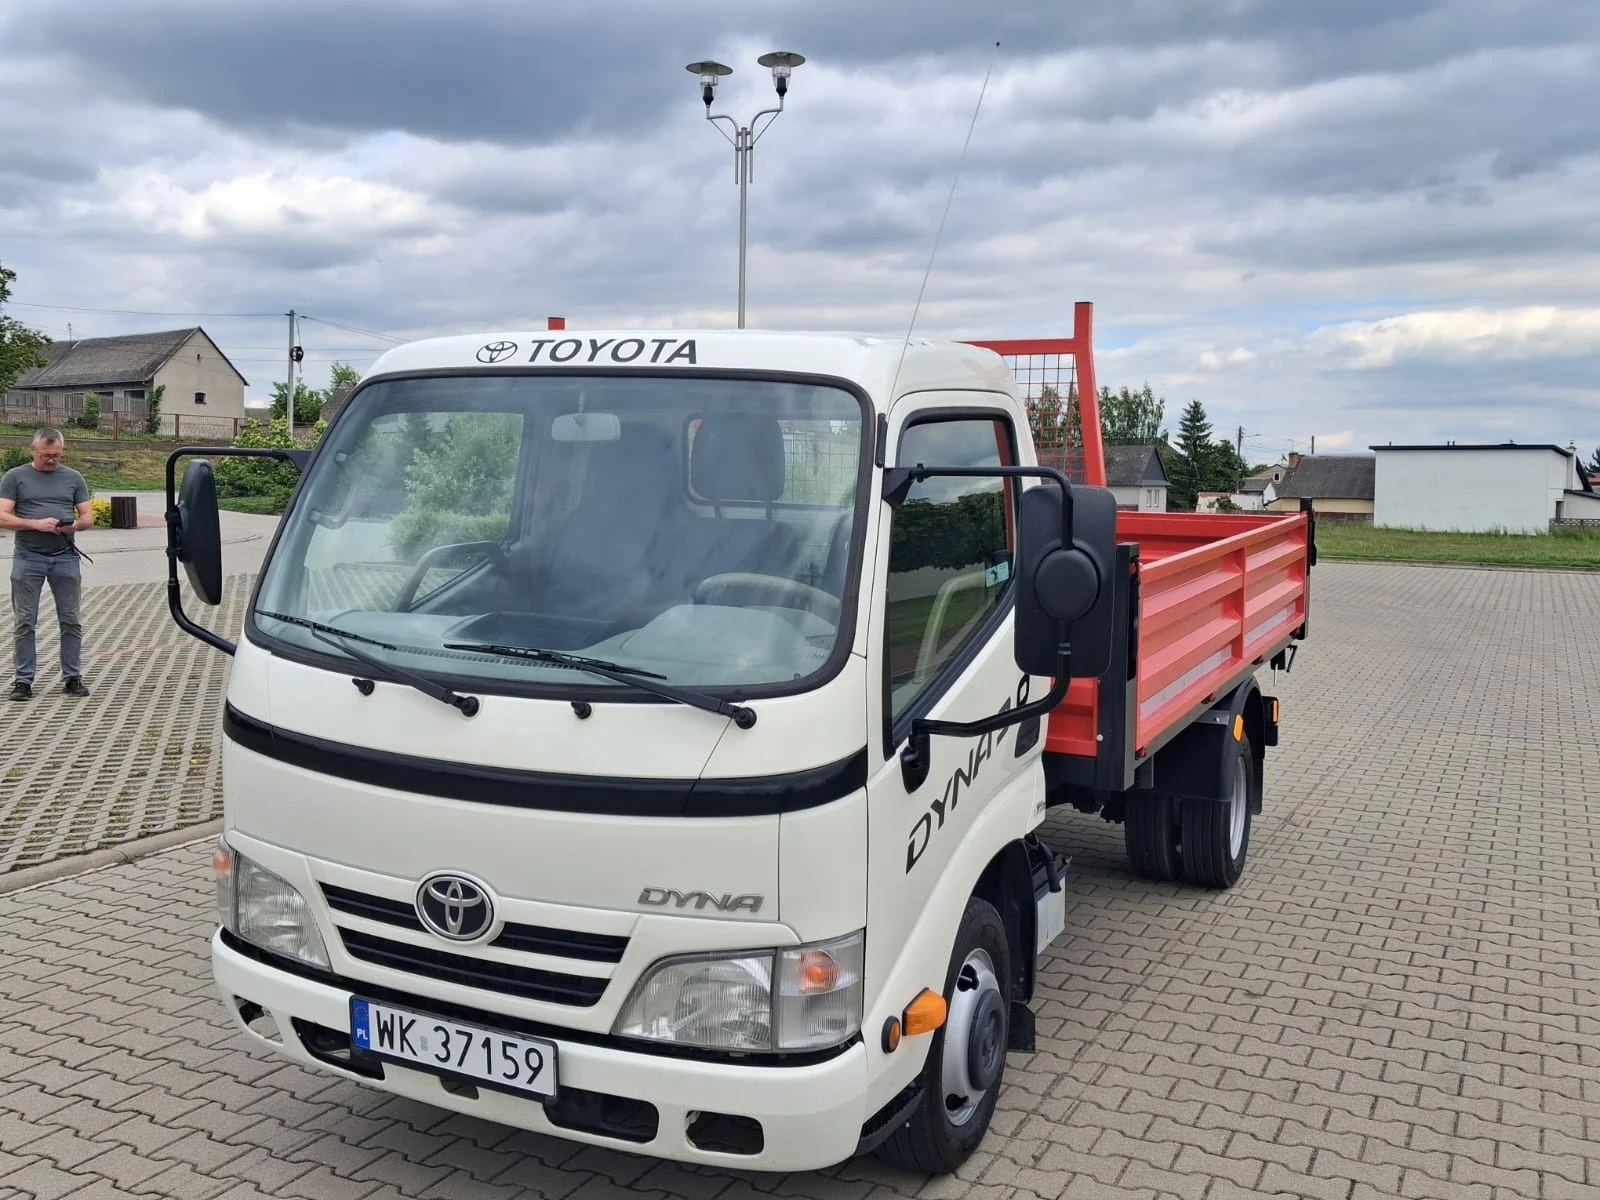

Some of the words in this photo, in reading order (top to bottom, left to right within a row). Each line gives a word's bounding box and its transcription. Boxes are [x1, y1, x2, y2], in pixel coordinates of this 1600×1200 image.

[528, 338, 697, 364] TOYOTA
[638, 887, 764, 912] DYNA
[356, 1028, 368, 1040] PL
[376, 1010, 417, 1056] WK
[433, 1025, 544, 1085] 37159
